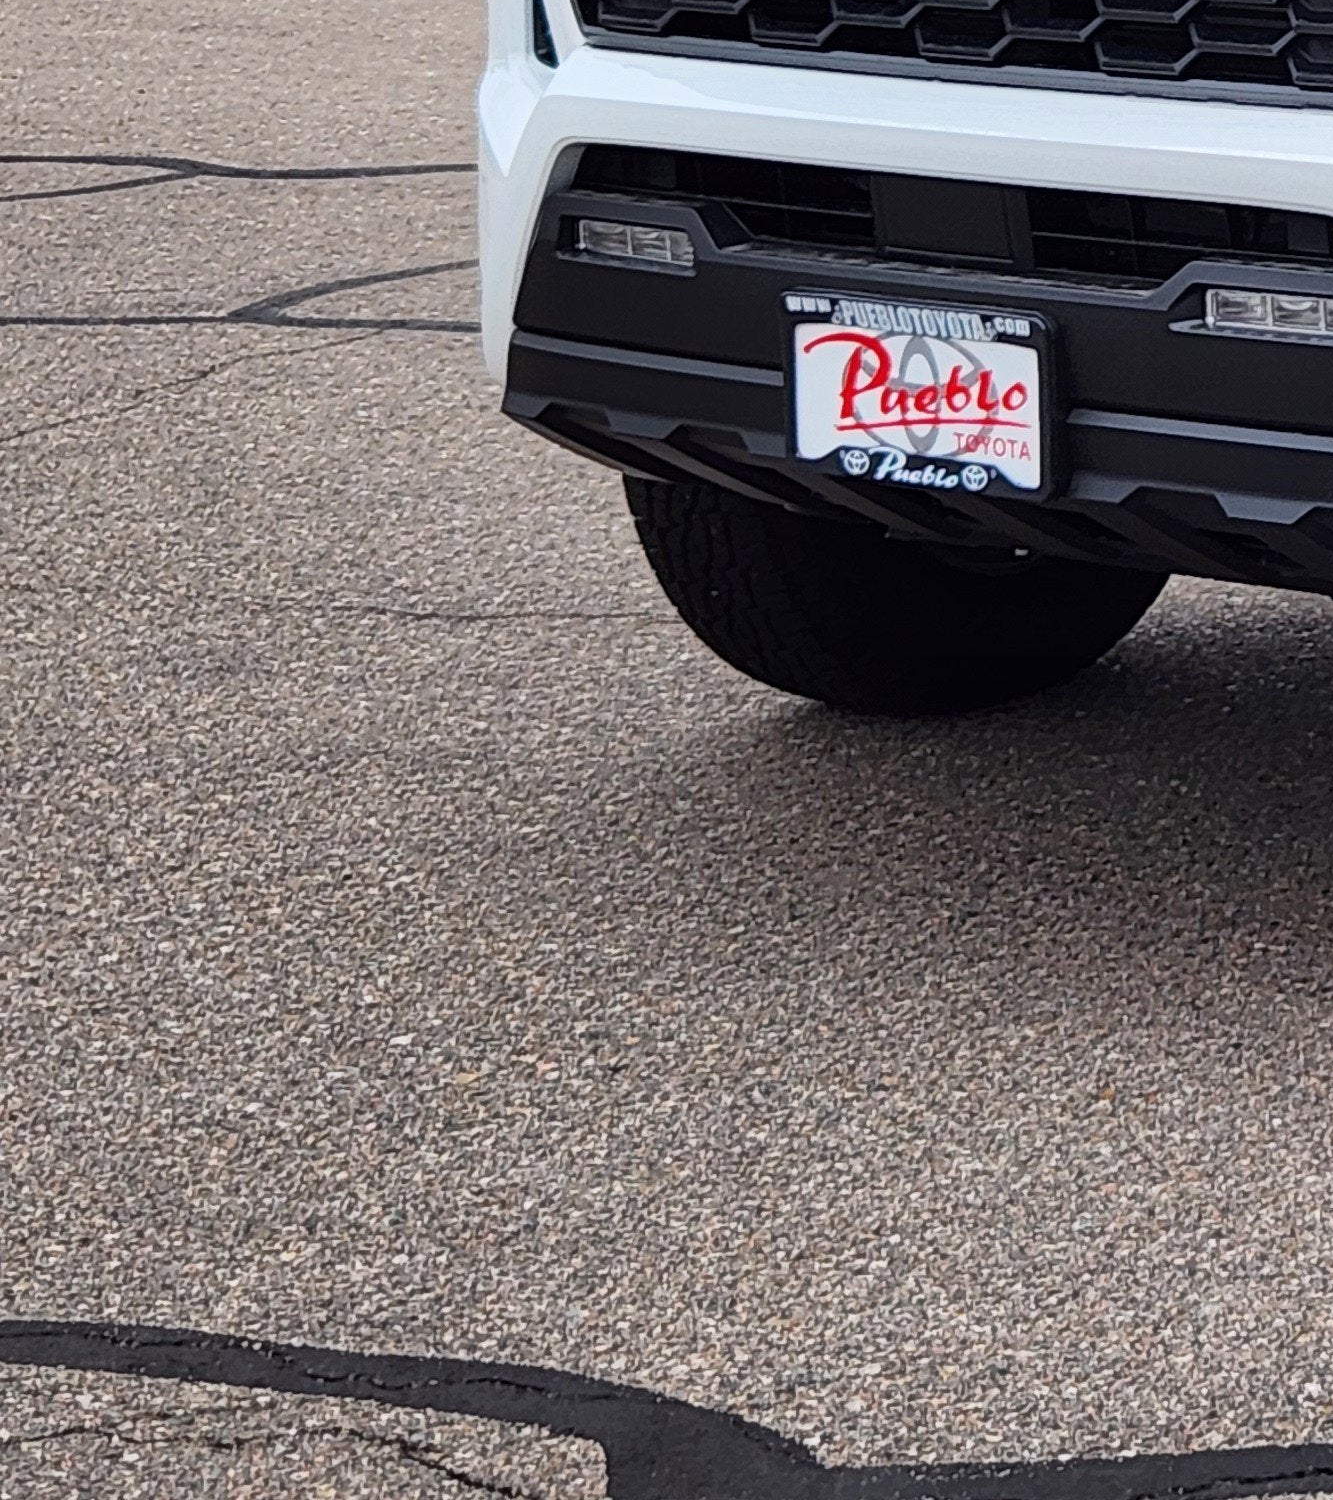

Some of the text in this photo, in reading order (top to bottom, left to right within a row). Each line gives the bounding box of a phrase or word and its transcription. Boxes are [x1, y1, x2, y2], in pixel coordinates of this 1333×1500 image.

[803, 332, 1028, 419] Pueblo
[868, 446, 959, 489] Pueblo
[953, 432, 1032, 462] TOYOTA
